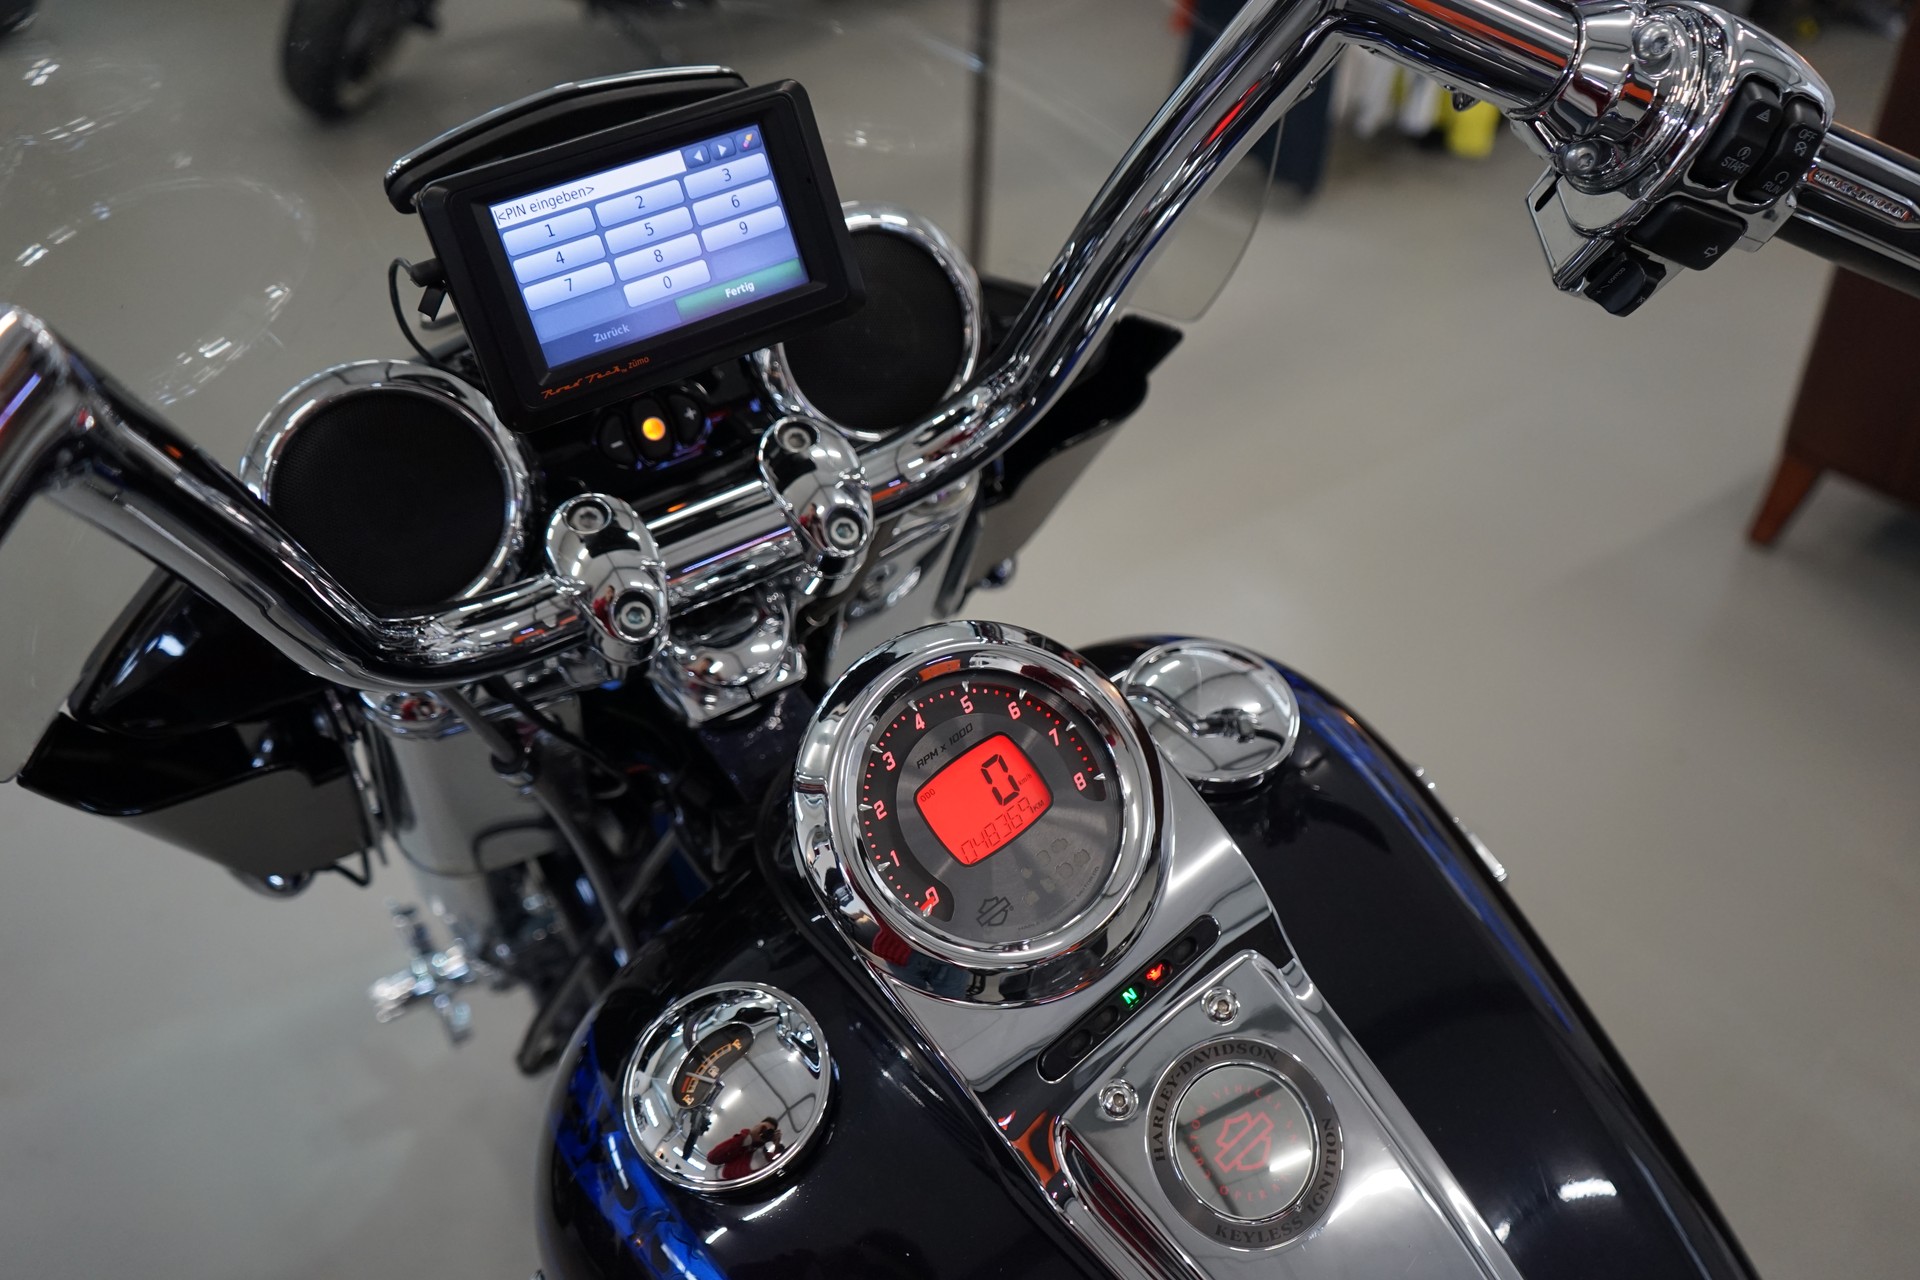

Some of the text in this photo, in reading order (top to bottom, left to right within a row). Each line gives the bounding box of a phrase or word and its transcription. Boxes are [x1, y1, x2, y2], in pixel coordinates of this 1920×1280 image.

[1798, 128, 1818, 142] OFF
[1720, 156, 1750, 174] START
[722, 168, 732, 182] 3
[1762, 180, 1784, 194] RUN
[530, 185, 594, 214] eingeben>
[635, 195, 646, 210] 2
[730, 194, 741, 208] 6
[546, 224, 556, 238] 1
[644, 222, 655, 236] 5
[738, 221, 749, 235] 9
[555, 251, 565, 264] 4
[653, 250, 664, 263] 8
[564, 278, 574, 292] 7
[662, 276, 672, 290] 0
[724, 280, 755, 300] Fertig
[593, 322, 631, 343] Zurück
[541, 378, 583, 399] Road
[959, 695, 974, 714] 5
[1007, 702, 1022, 720] 6
[914, 713, 926, 730] 4
[916, 748, 939, 769] RPM
[949, 722, 974, 745] 1000
[1048, 729, 1060, 746] 7
[882, 752, 896, 771] 3
[980, 754, 1020, 806] 0
[1018, 773, 1033, 786] km/h
[1073, 772, 1088, 792] 8
[874, 800, 888, 820] 2
[960, 796, 1045, 864] 048369 KM
[890, 850, 900, 867] 1
[925, 886, 940, 906] 0
[1122, 987, 1138, 1004] N
[732, 1038, 744, 1050] F
[682, 1094, 695, 1106] E
[1155, 1043, 1277, 1162] HARLEY-DAVIDSON
[1307, 1118, 1338, 1215] IGNITION
[1215, 1218, 1303, 1244] KEYLESS
